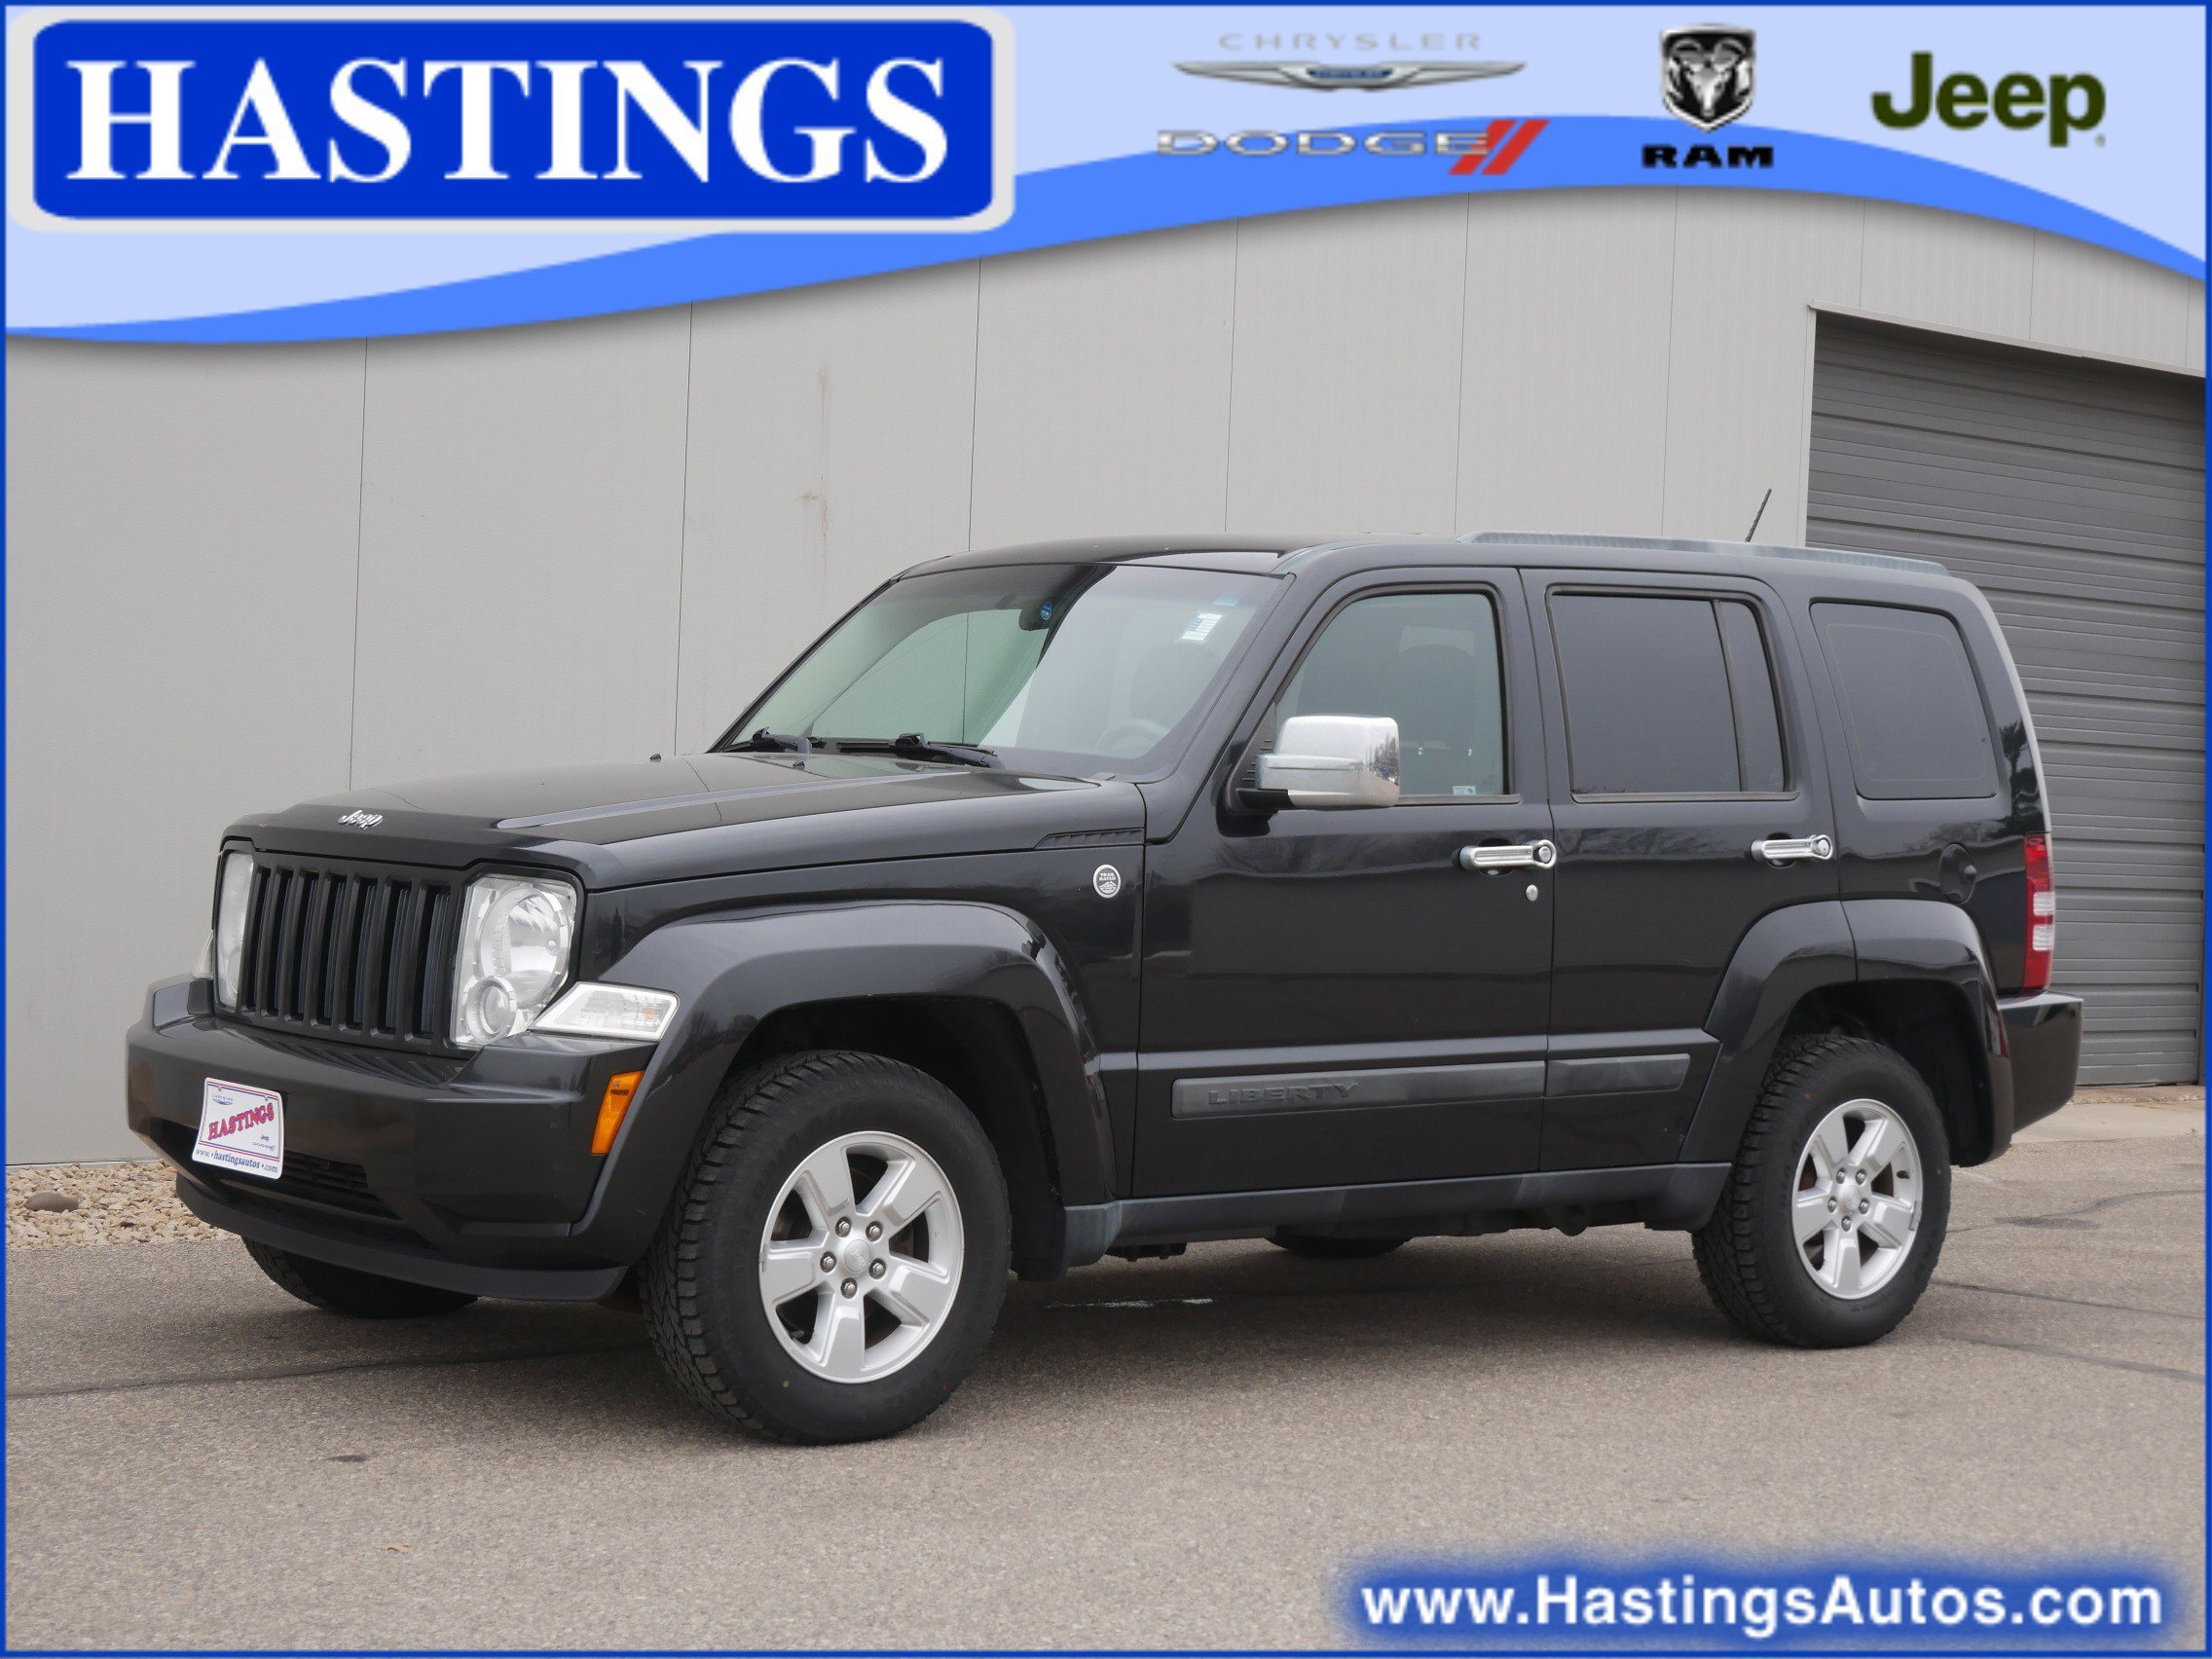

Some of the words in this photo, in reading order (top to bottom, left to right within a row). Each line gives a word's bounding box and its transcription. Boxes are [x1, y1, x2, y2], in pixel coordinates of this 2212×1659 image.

[338, 809, 384, 830] Jeep
[1207, 1081, 1359, 1105] LIBERTY
[207, 1102, 275, 1140] HASTINGS
